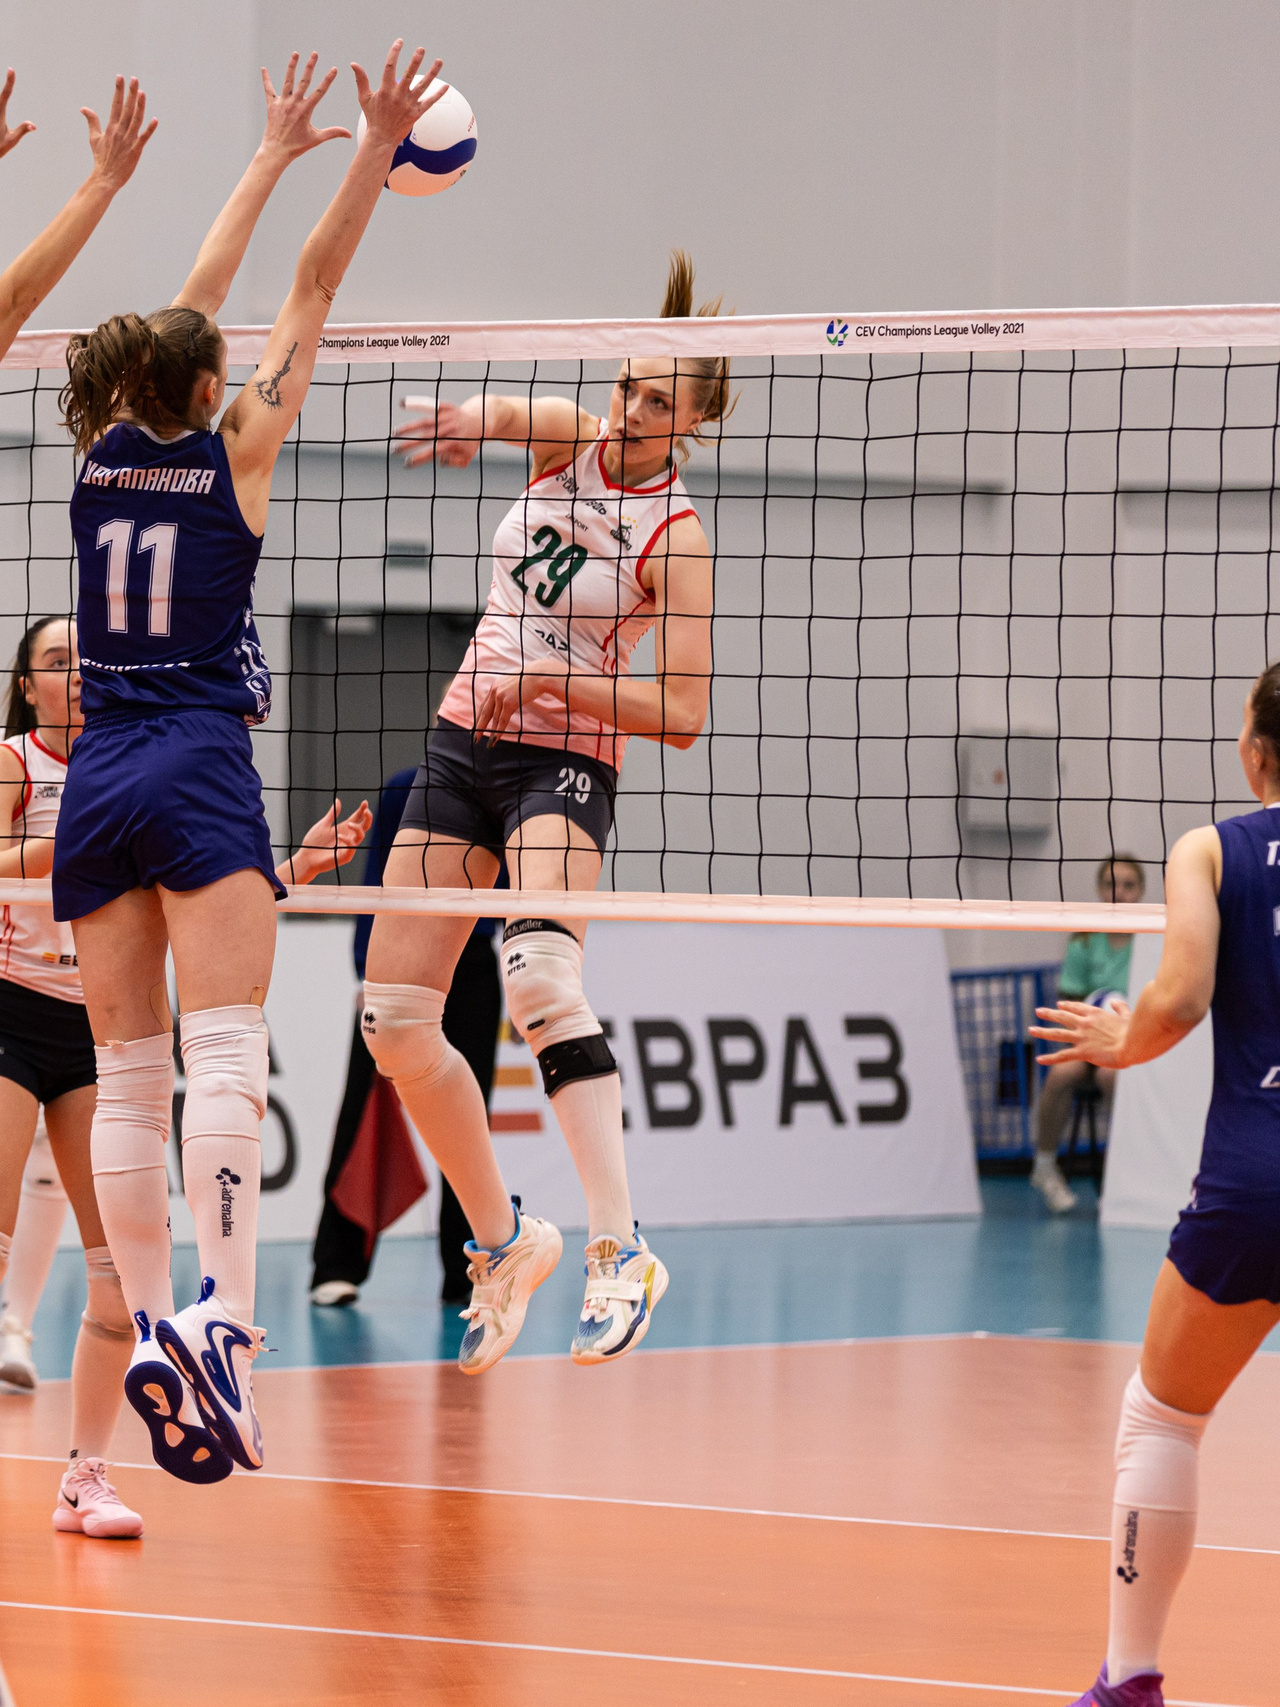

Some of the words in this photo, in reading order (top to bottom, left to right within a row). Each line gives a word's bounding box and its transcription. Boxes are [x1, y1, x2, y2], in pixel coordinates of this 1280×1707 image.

[367, 337, 400, 349] League
[401, 335, 428, 348] Volley
[430, 335, 450, 346] 2021
[855, 326, 875, 337] CEV
[877, 325, 932, 338] Champions
[934, 325, 969, 338] League
[971, 324, 1000, 337] Volley
[1003, 323, 1025, 334] 2021
[96, 518, 178, 637] 11
[510, 525, 588, 608] 29
[554, 767, 592, 804] 29
[598, 1015, 912, 1131] ВРАЗ
